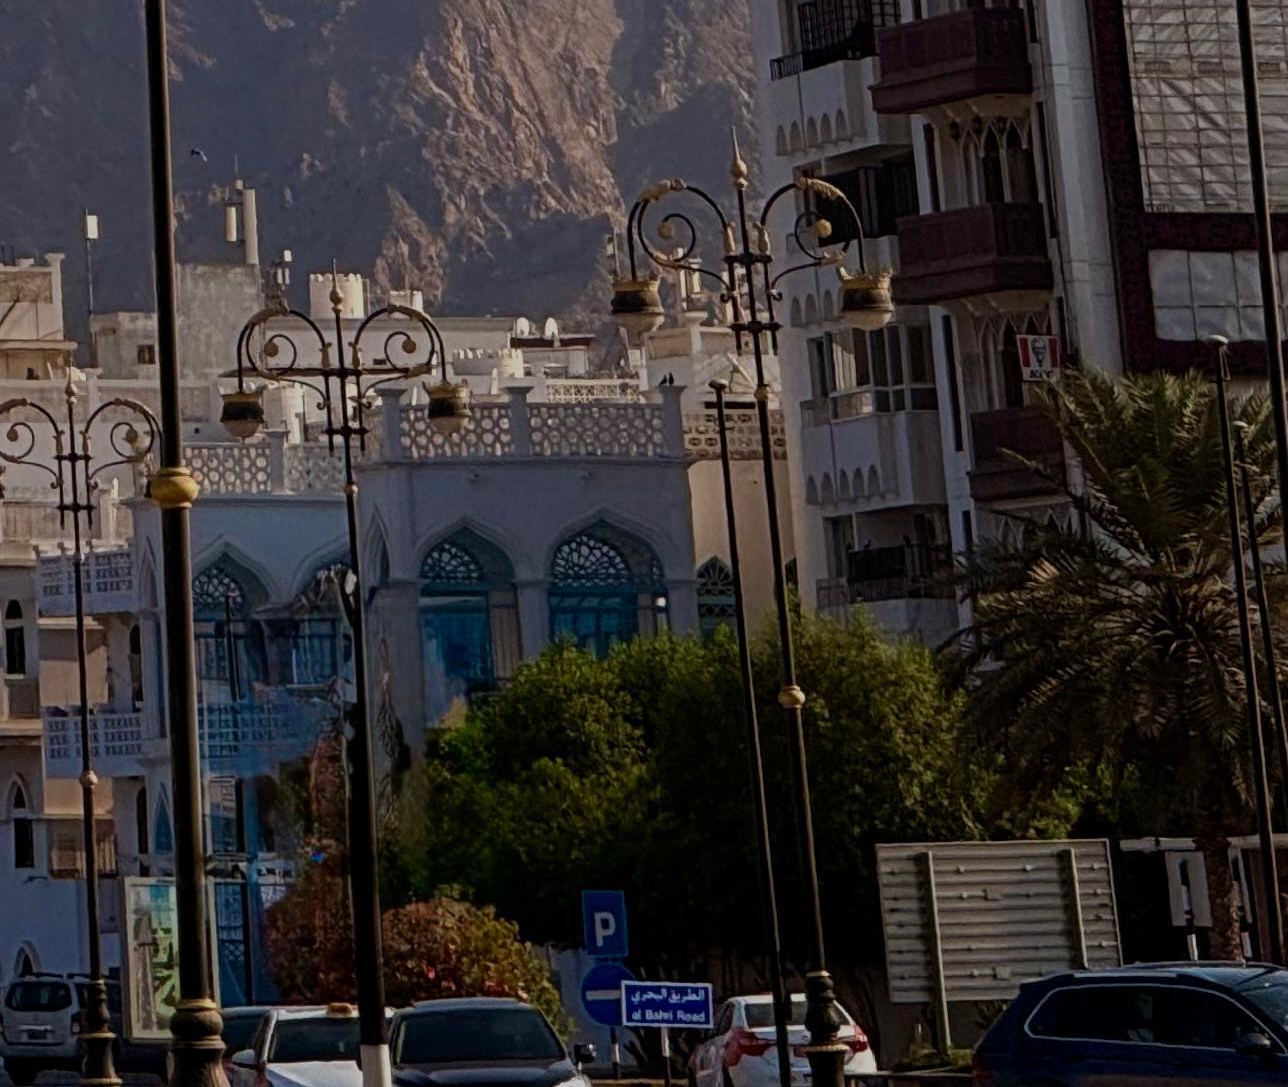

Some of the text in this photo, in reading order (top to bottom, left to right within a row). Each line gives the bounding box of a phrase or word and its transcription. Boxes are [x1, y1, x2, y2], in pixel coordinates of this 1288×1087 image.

[593, 911, 616, 948] P
[630, 987, 705, 1005] الطريق البحري
[676, 1009, 706, 1023] Road
